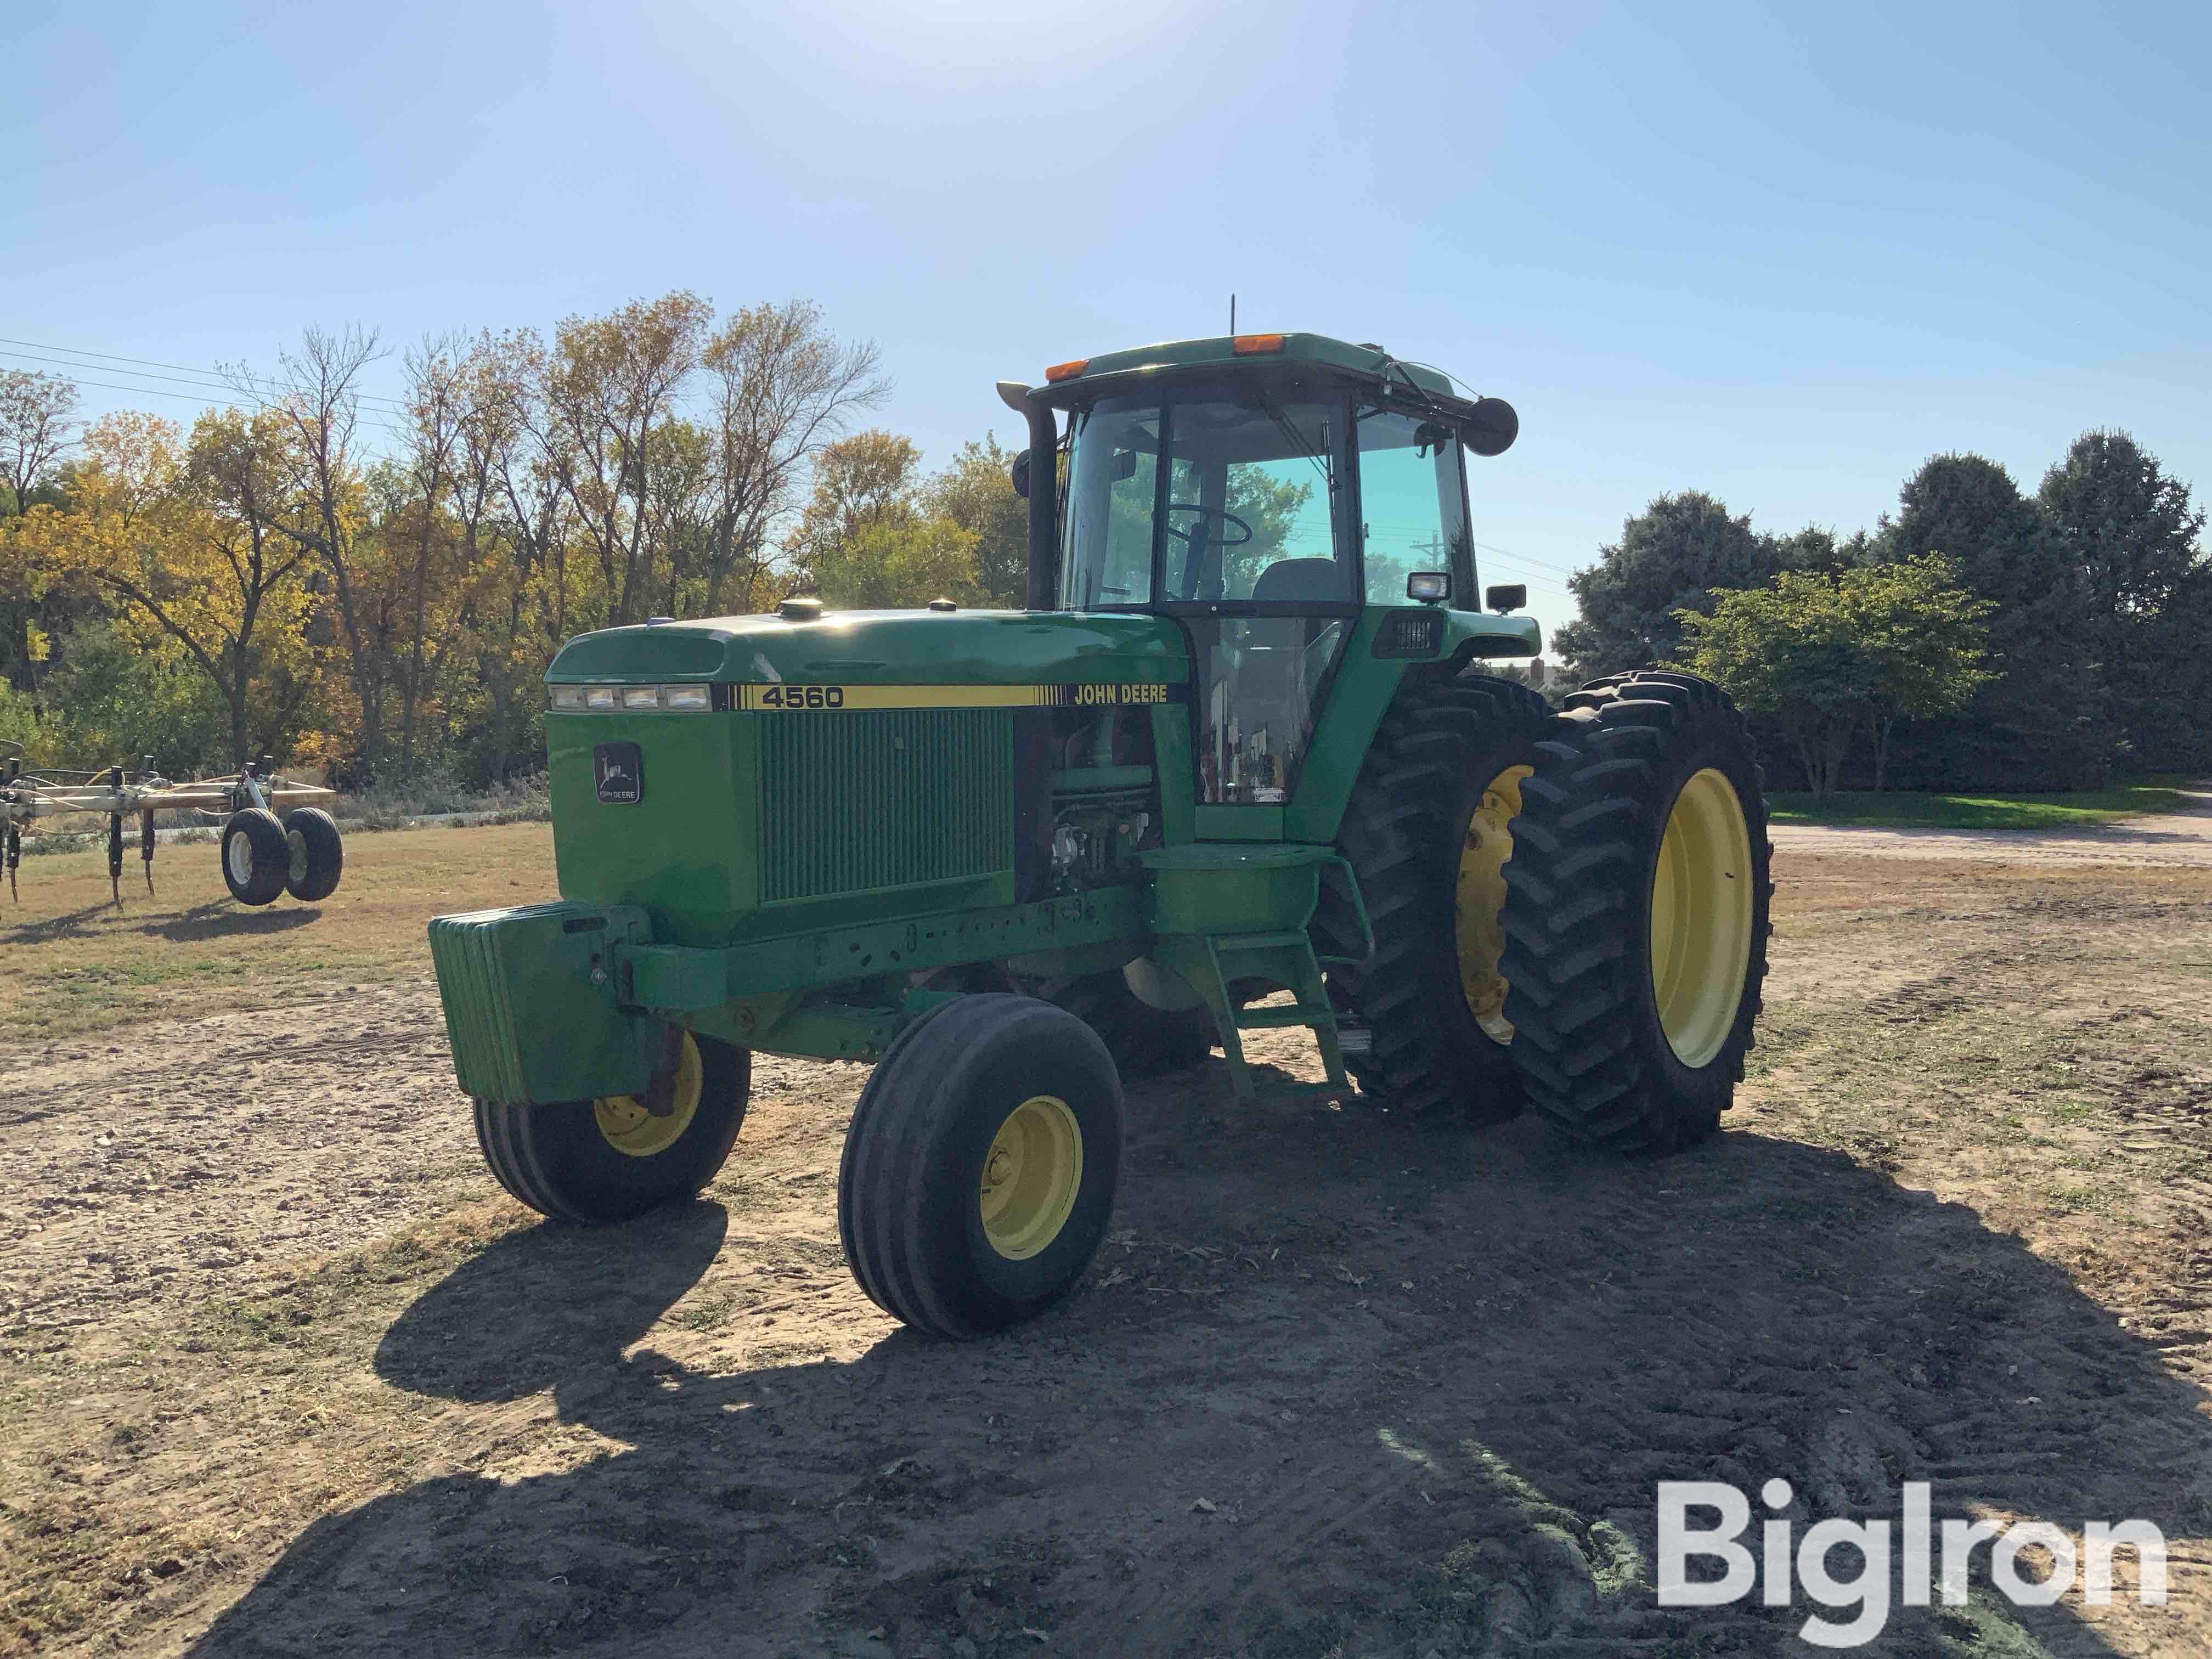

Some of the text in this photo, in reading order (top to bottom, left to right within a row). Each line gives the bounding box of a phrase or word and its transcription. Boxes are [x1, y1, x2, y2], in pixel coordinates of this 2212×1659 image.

[763, 687, 843, 708] 4560
[1075, 684, 1167, 705] JOHN DEERE
